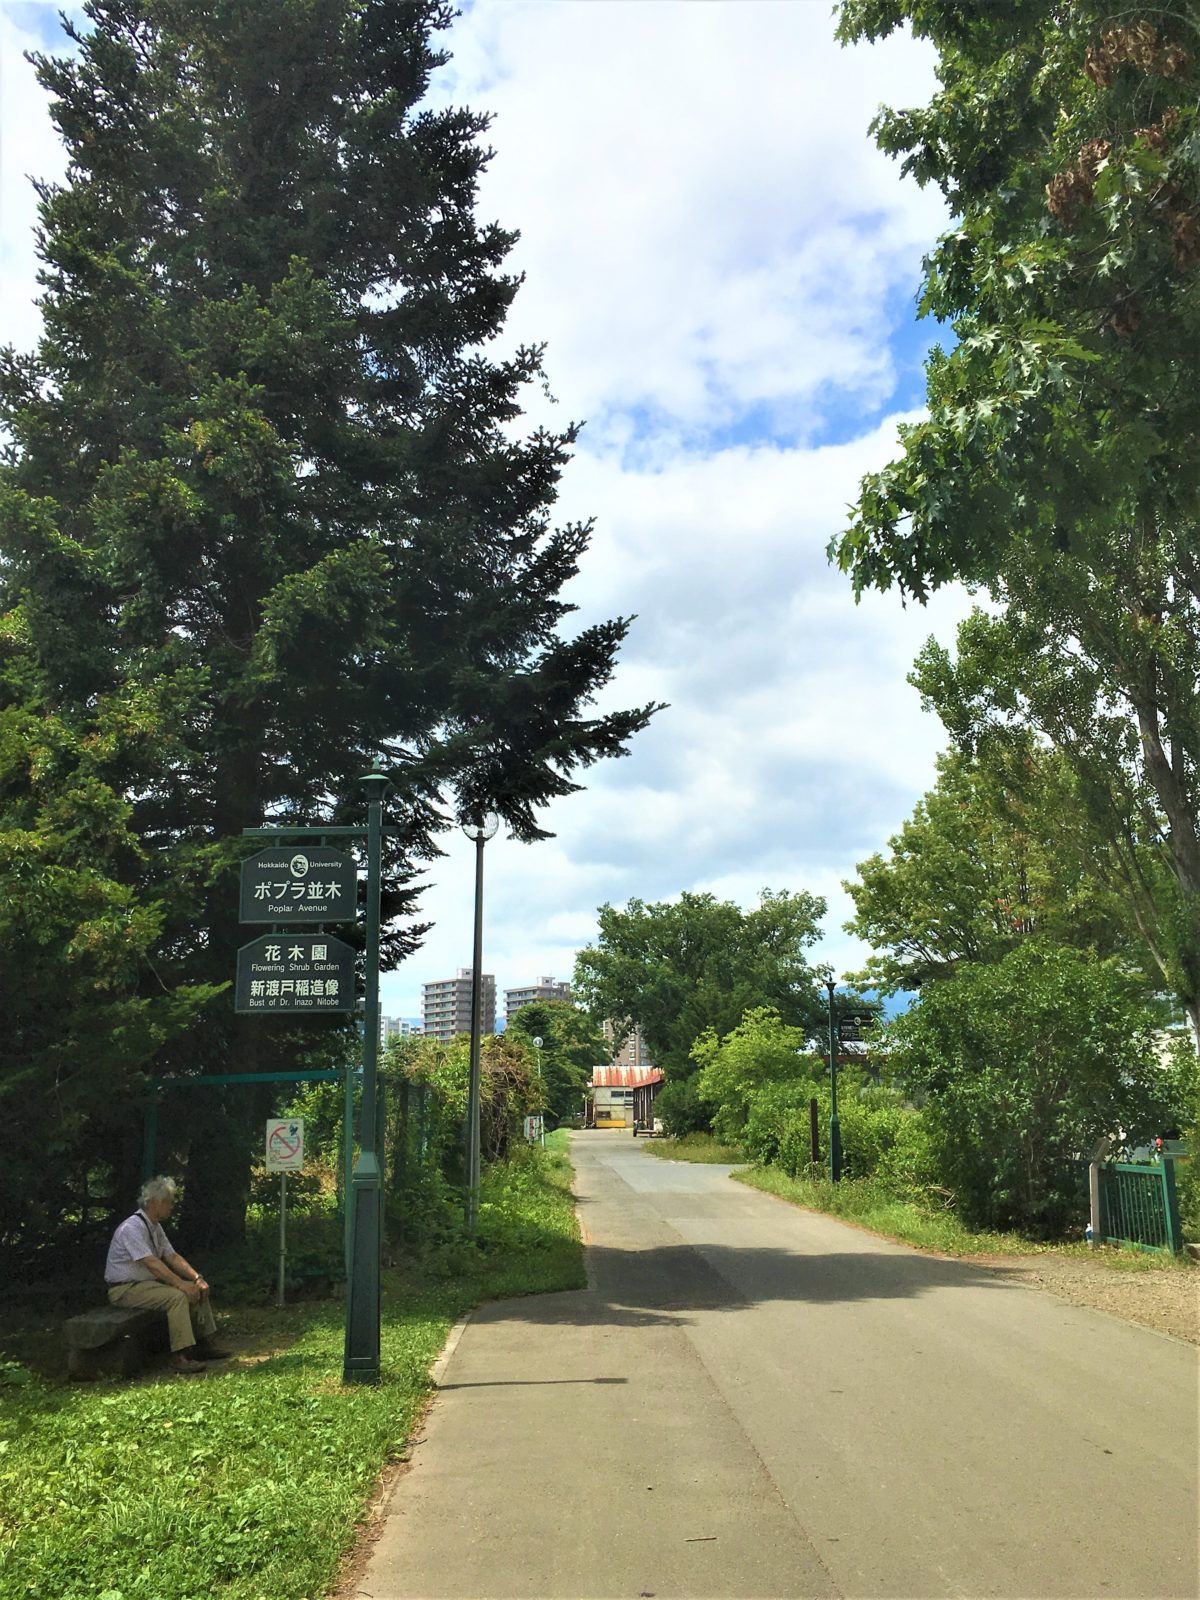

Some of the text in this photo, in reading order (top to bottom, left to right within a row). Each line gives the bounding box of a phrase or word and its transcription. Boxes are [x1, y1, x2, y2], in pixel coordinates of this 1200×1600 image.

[309, 861, 342, 869] University
[254, 880, 341, 900] ポプラ並木
[268, 904, 328, 913] Poplar Avenue
[251, 963, 340, 972] Flowering Shrub Garden
[250, 979, 339, 997] 新渡戸稲造像
[249, 998, 340, 1007] Bust of Dr. Inazo Nitobe
